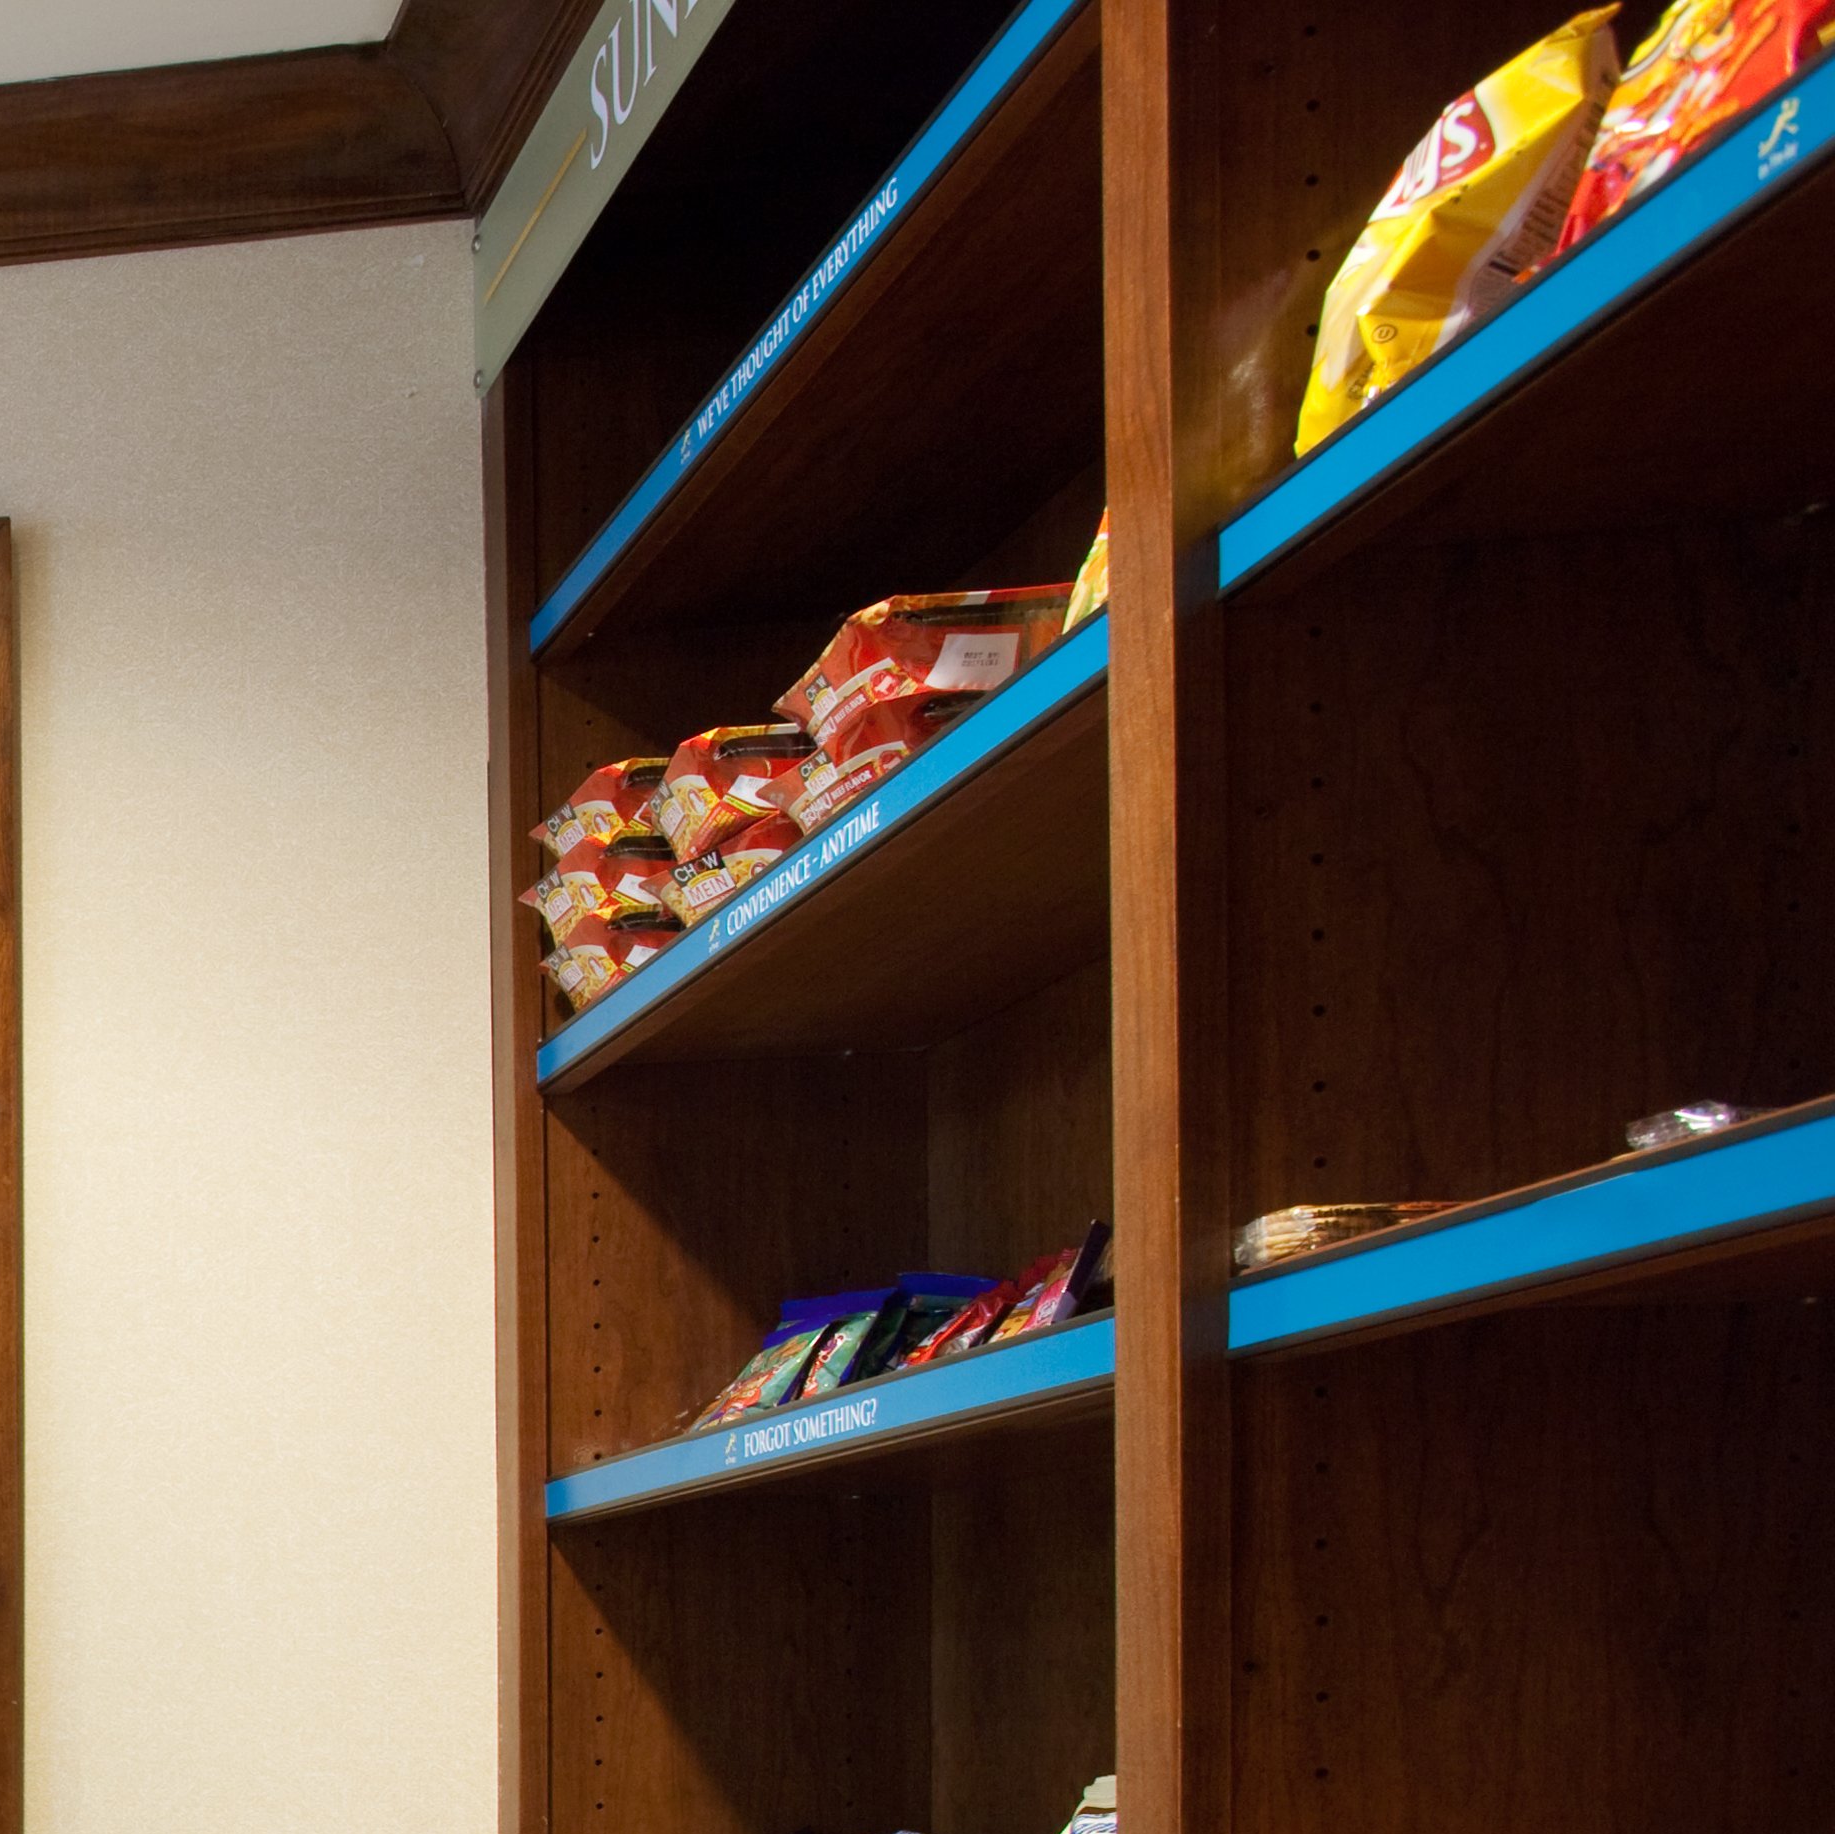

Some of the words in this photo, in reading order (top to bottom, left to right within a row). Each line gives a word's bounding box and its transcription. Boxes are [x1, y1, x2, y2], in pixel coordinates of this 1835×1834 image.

[590, 0, 699, 169] SUN
[697, 384, 729, 439] WE'VE
[731, 308, 791, 398] THOUGHT
[792, 284, 810, 323] OF
[812, 177, 898, 301] EVERYTHING
[674, 851, 719, 883] CHOW
[688, 877, 728, 903] MEIN
[727, 854, 811, 936] CONVENIENCE
[819, 800, 880, 870] ANYTIME
[744, 1422, 792, 1458] FORGOT
[793, 1398, 877, 1442] SOMETHING?
